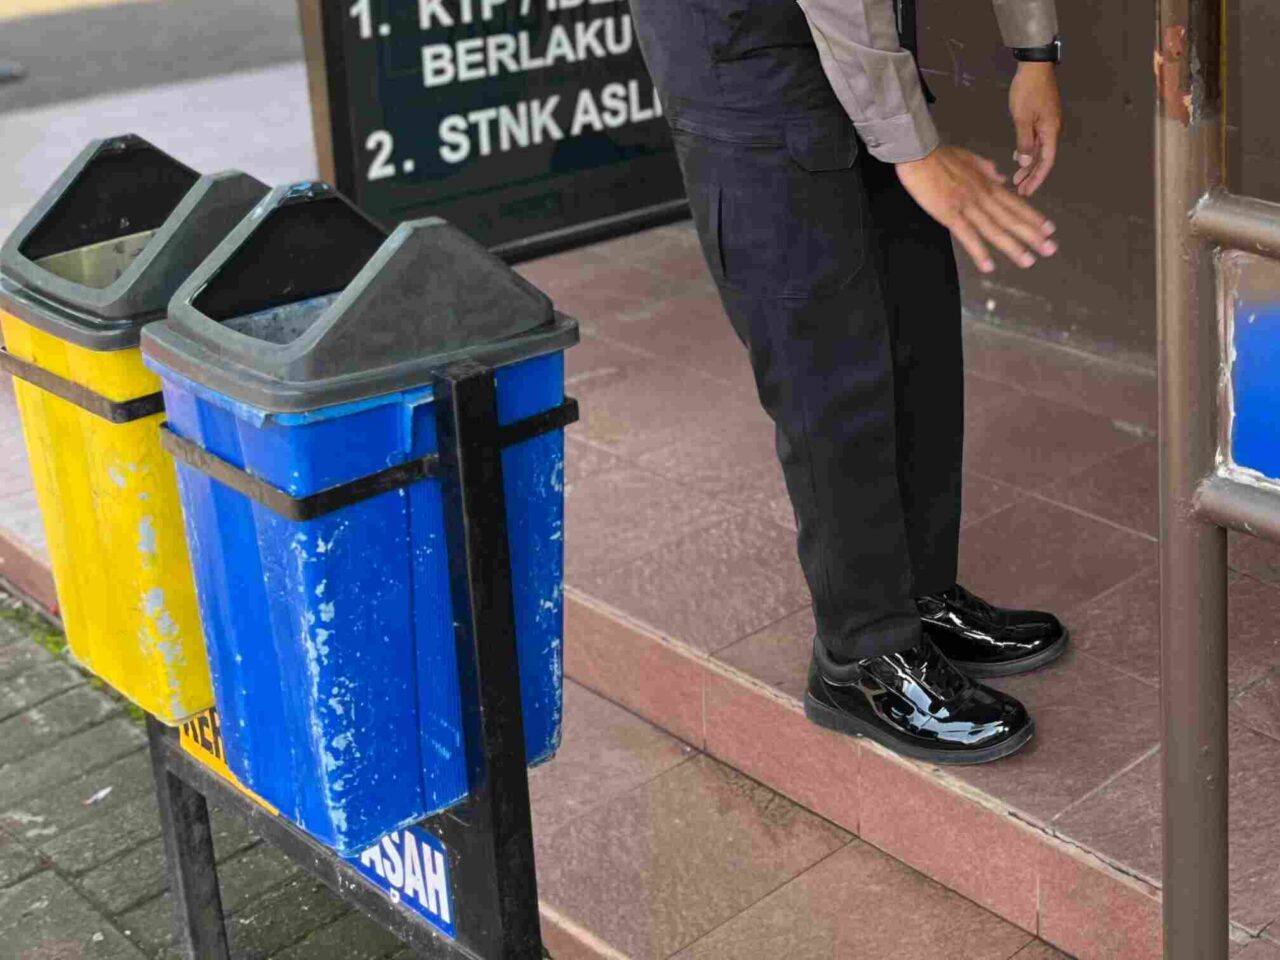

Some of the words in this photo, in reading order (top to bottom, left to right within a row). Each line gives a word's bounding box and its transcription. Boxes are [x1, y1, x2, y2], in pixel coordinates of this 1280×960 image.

[421, 14, 633, 88] BERLAKU
[365, 129, 415, 181] 2.
[438, 94, 564, 164] STNK
